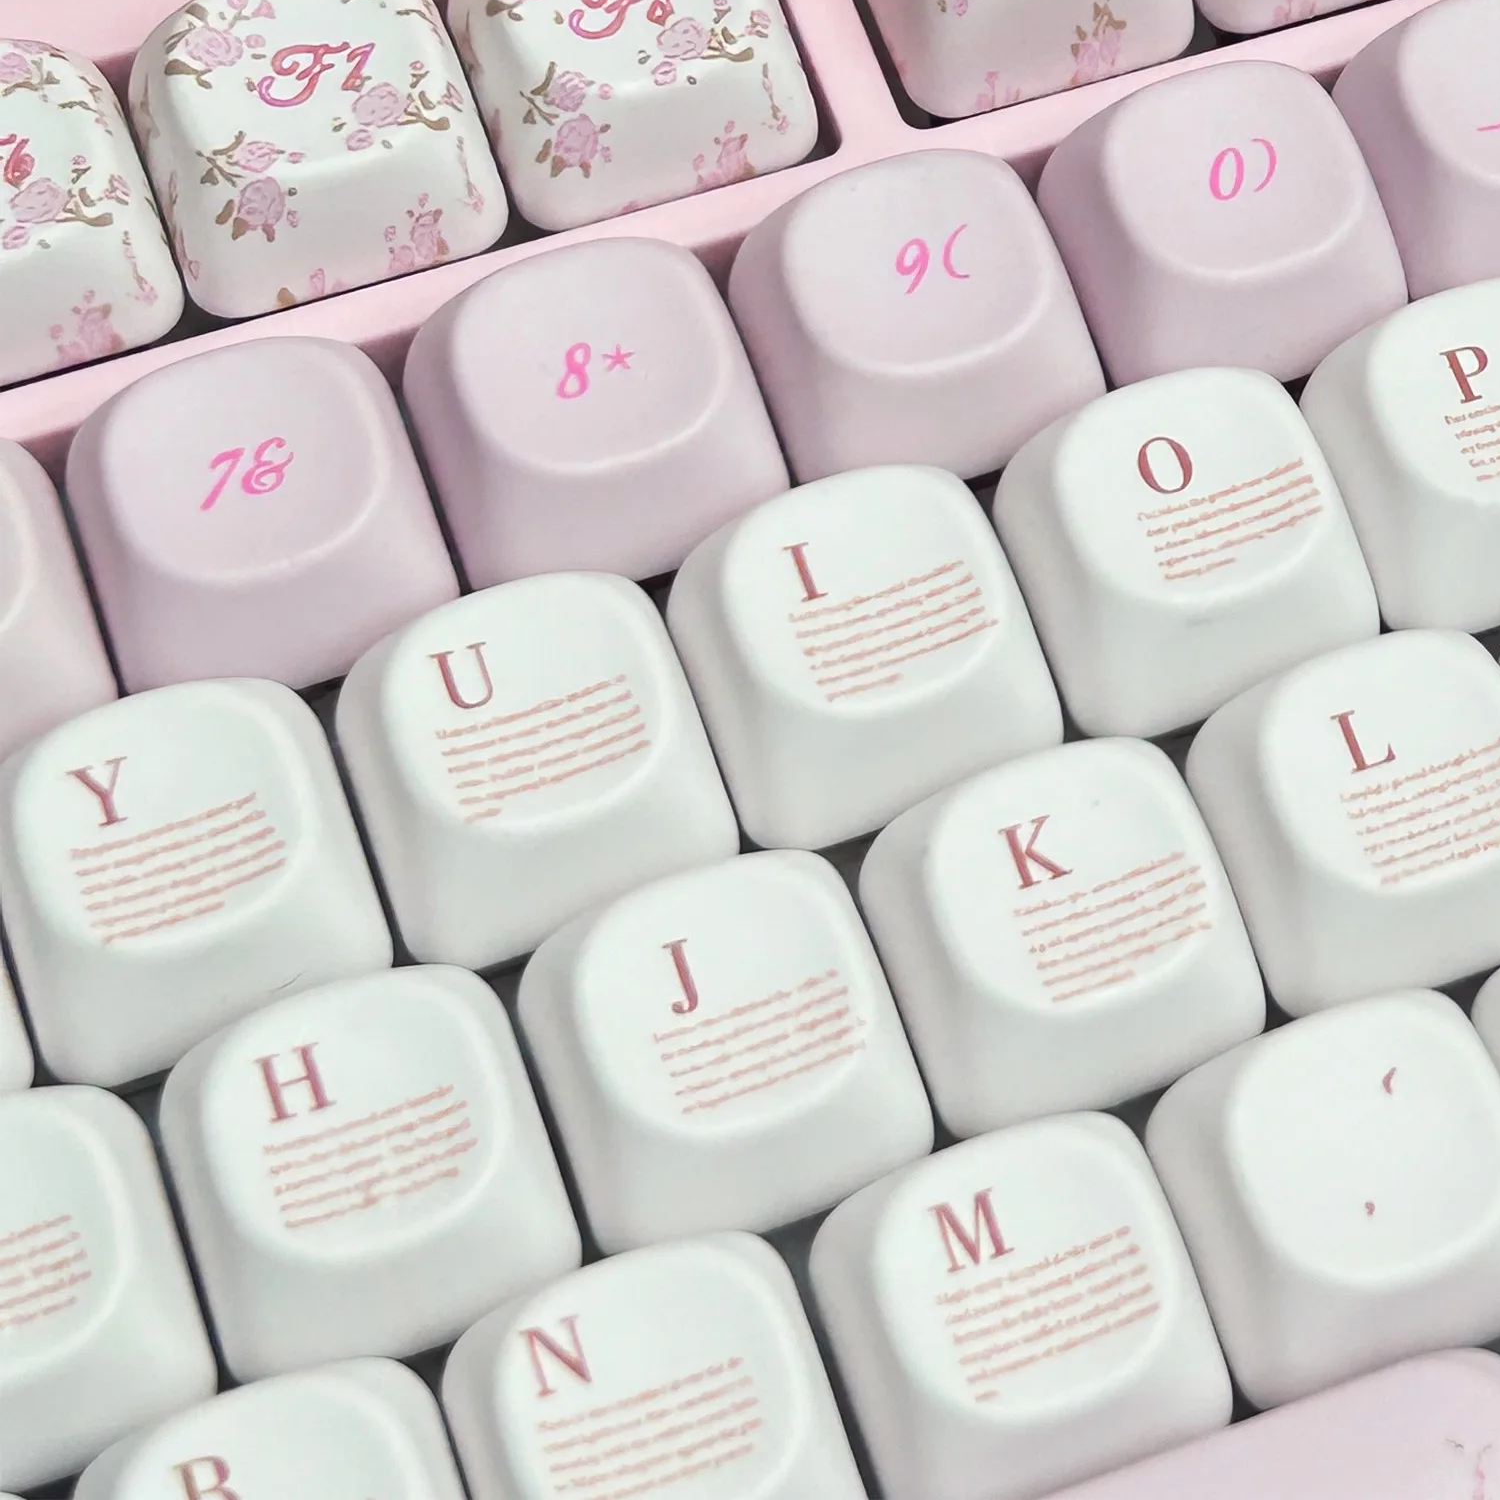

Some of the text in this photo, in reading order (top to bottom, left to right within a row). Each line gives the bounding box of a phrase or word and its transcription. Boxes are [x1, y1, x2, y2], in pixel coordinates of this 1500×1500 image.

[1439, 345, 1489, 404] P
[1137, 436, 1194, 495] O
[428, 641, 496, 710] U
[1330, 709, 1398, 775] L
[65, 756, 130, 828] Y
[996, 814, 1074, 891] K
[660, 937, 702, 1016] J
[252, 1041, 337, 1124] H
[928, 1187, 1015, 1273] M
[519, 1314, 593, 1398] N
